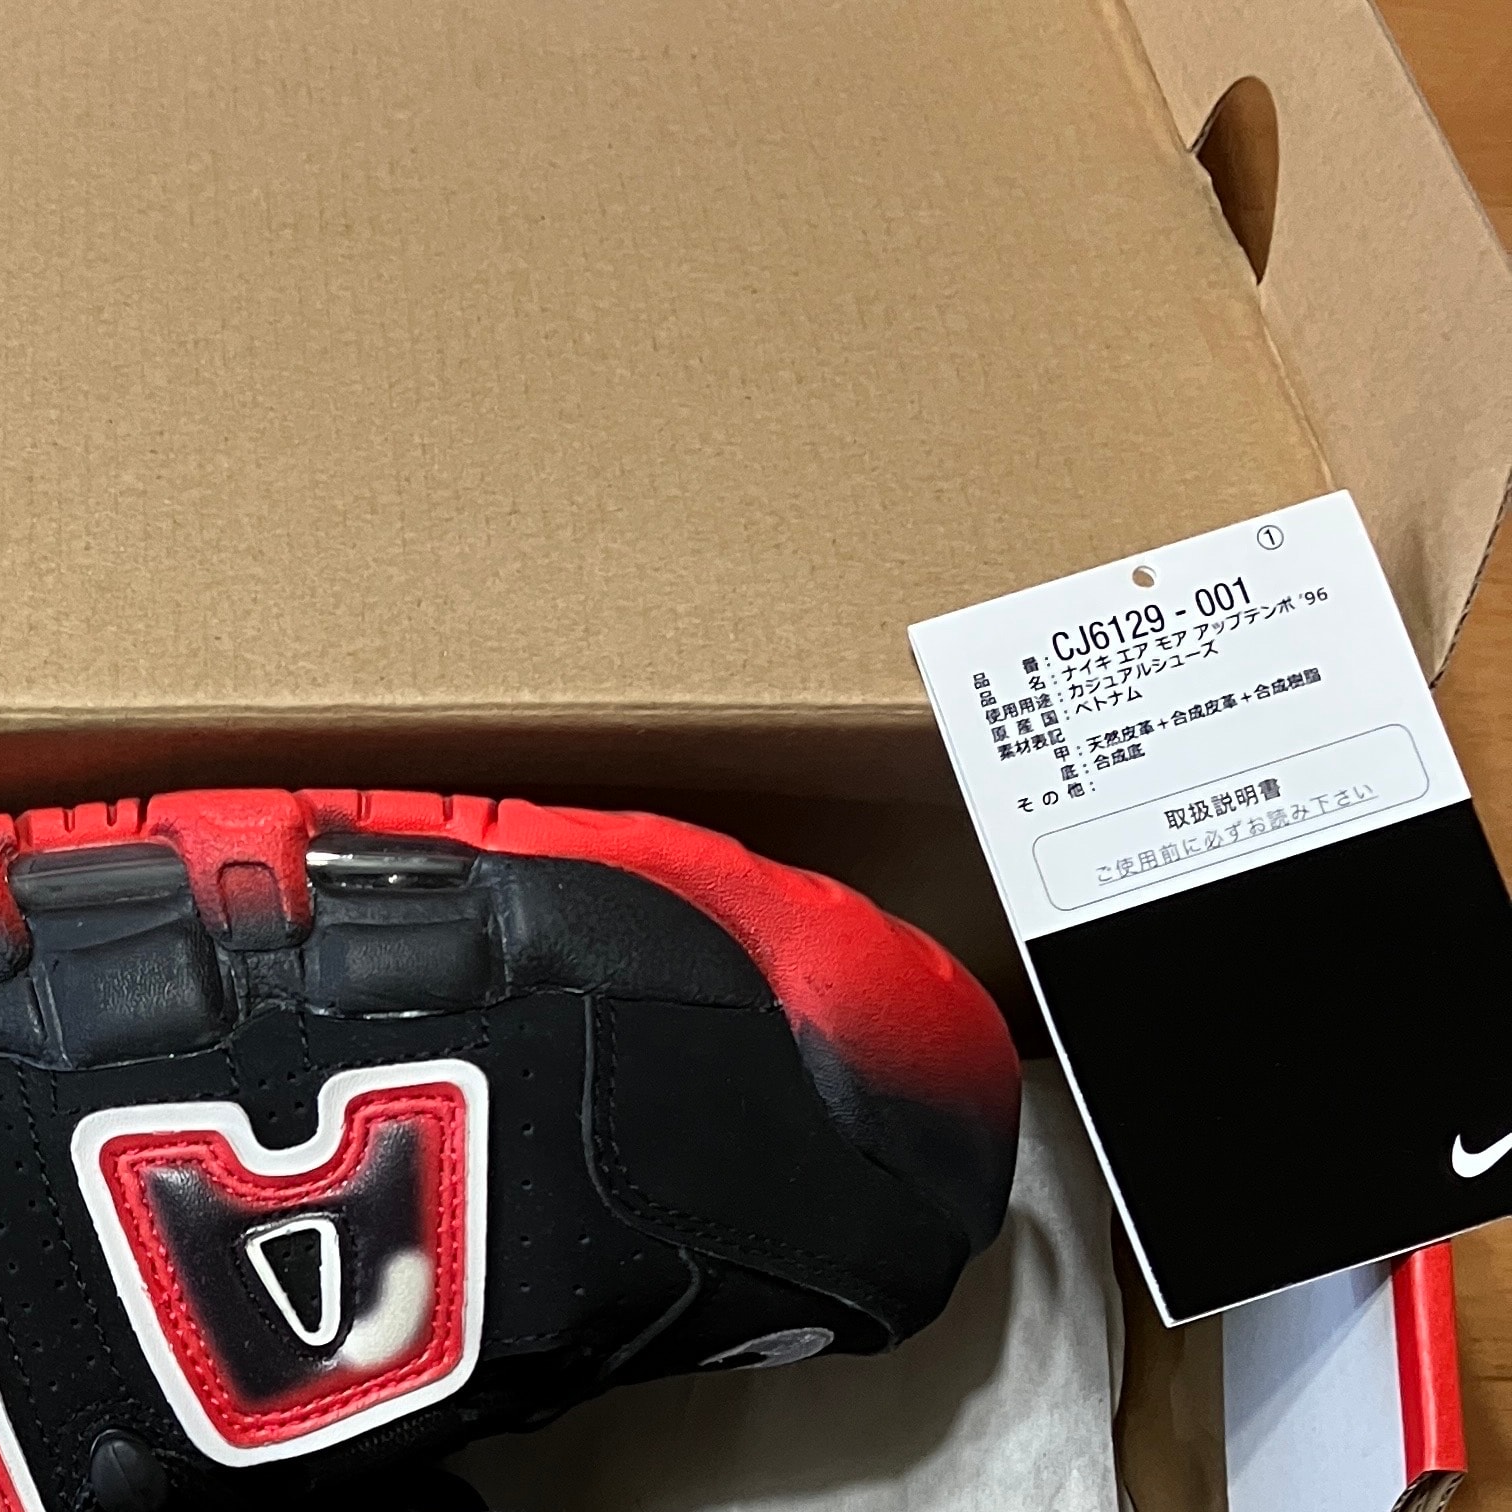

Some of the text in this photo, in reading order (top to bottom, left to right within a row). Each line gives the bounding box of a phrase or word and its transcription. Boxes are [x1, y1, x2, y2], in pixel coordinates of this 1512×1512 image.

[1052, 604, 1165, 661] CJ6129
[1194, 576, 1251, 617] 001
[1062, 655, 1112, 682] ナイキ
[1116, 643, 1148, 664] エア
[1155, 630, 1187, 651] モア
[1068, 639, 1219, 700] カジュアルシューズ
[1095, 784, 1376, 882] ご使用前に必ずお読み下さい
[1164, 778, 1281, 830] 取扱説明書
